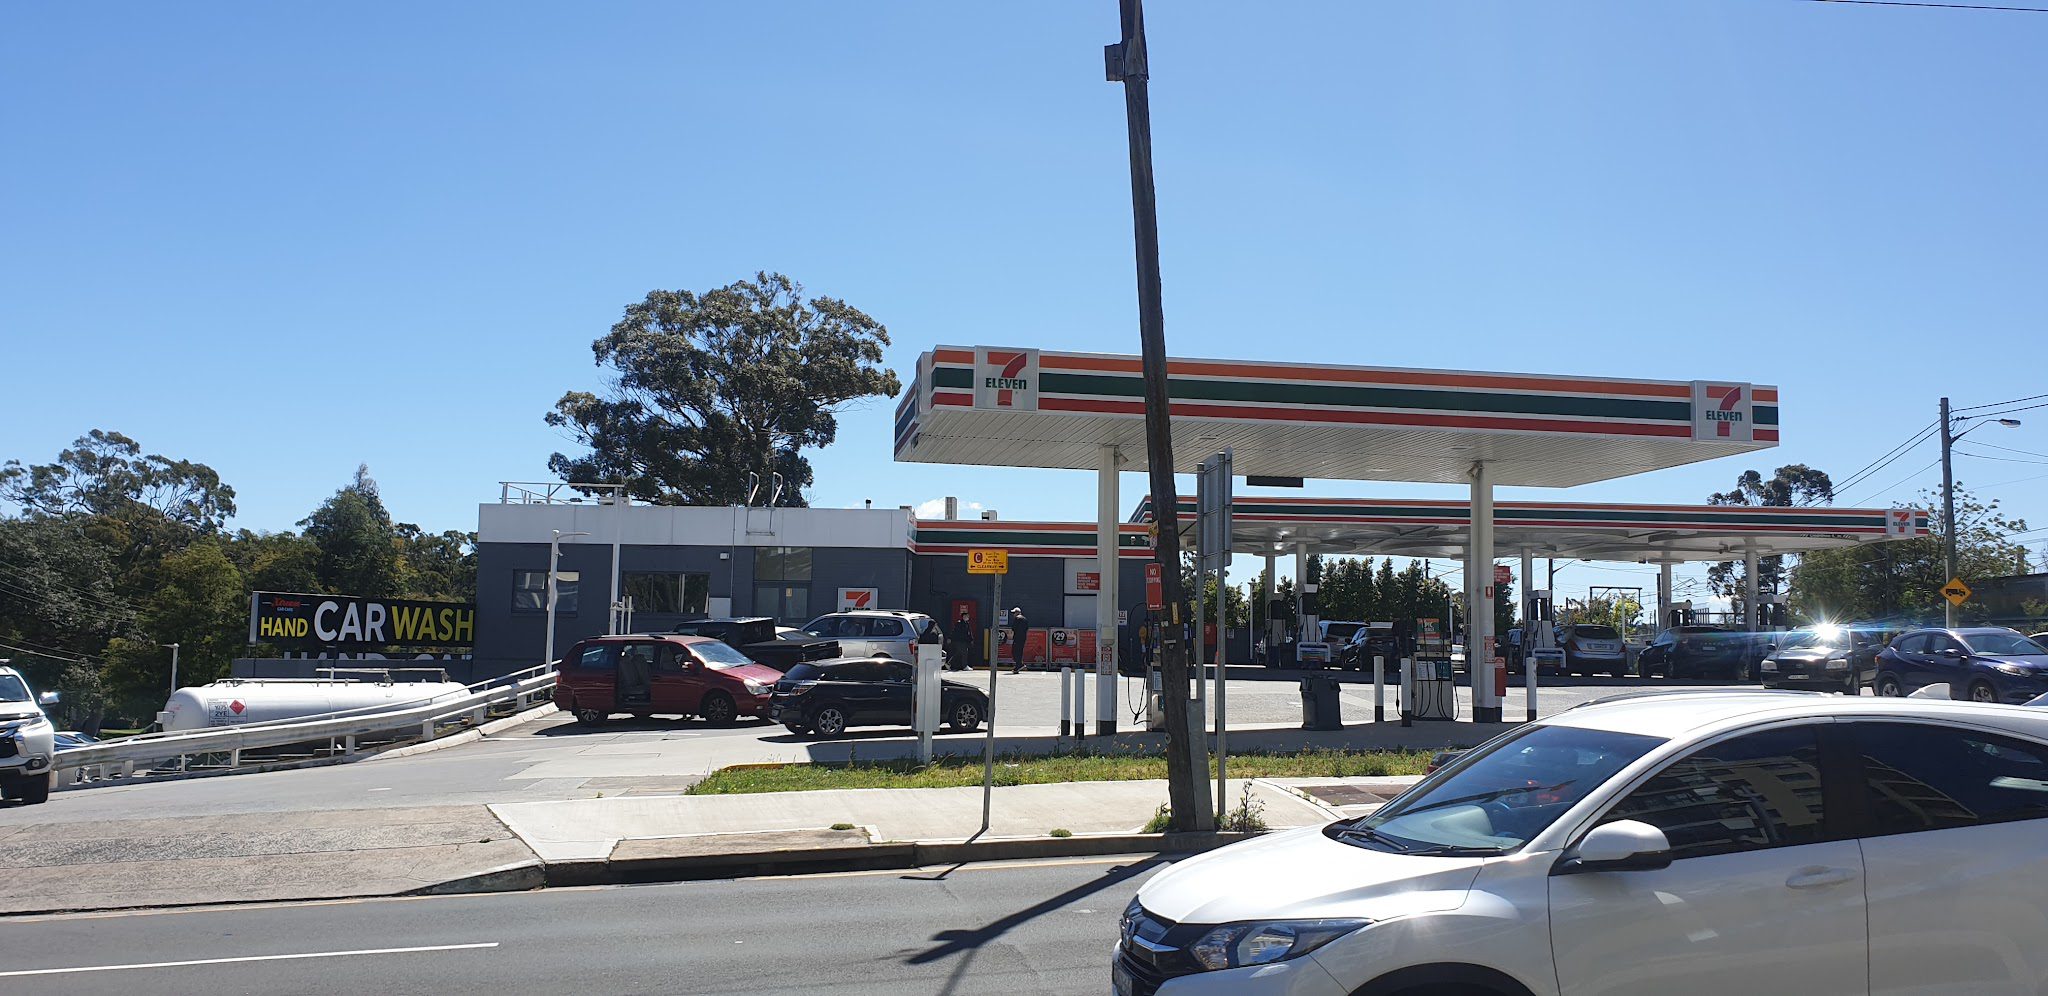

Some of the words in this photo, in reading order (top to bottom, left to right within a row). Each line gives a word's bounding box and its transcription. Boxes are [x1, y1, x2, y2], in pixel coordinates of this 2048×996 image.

[988, 352, 1027, 406] 7
[1706, 386, 1741, 437] 7
[1893, 511, 1910, 533] 7
[1149, 568, 1157, 576] NO
[260, 616, 309, 638] HAND
[314, 600, 387, 642] CAR
[391, 605, 474, 642] WASH
